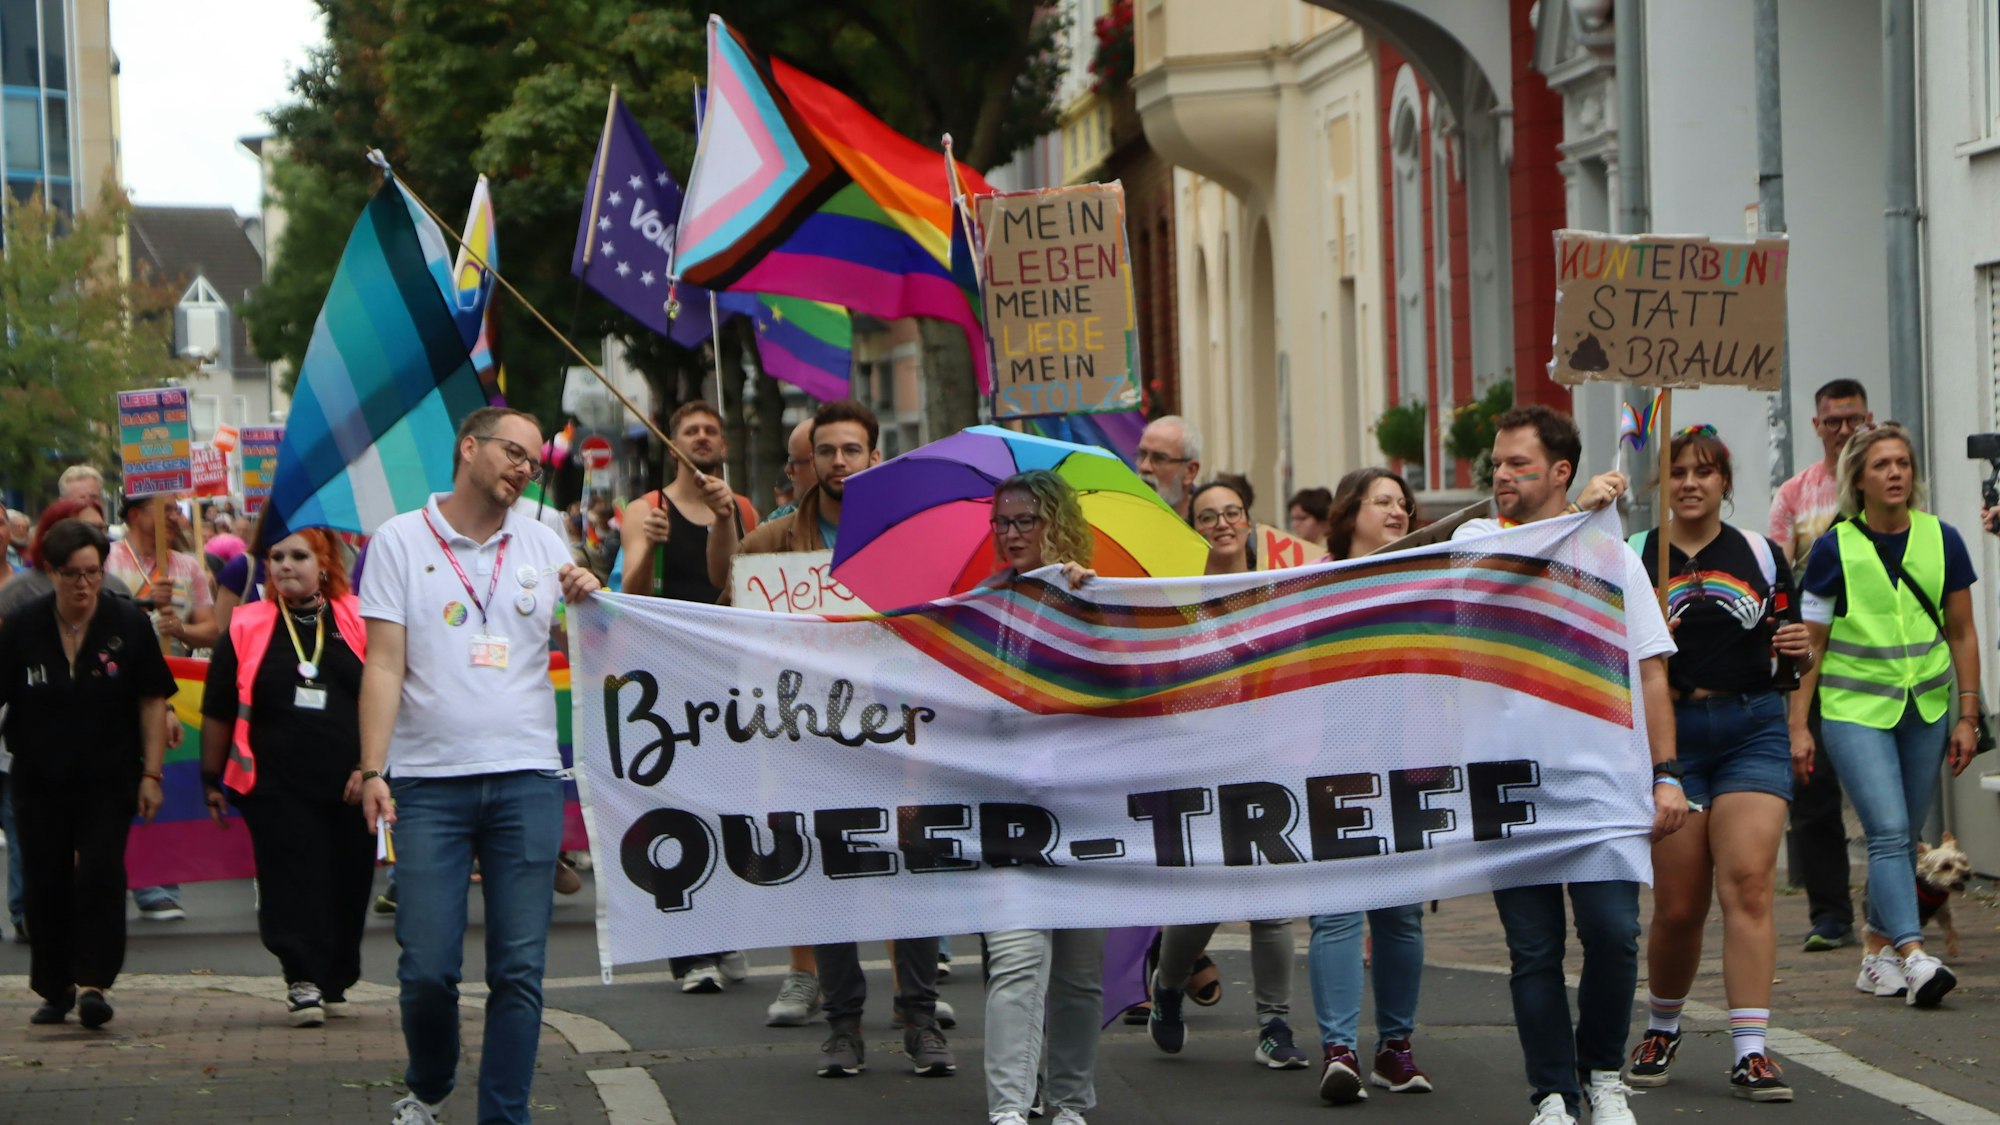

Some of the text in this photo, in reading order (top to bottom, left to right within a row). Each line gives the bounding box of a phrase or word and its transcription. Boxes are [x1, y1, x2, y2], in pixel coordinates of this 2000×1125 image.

[1003, 199, 1104, 243] MEIN
[988, 243, 1116, 287] LEBEN
[1560, 240, 1788, 286] KUNTERBUNT
[996, 284, 1092, 318] MEINE
[1588, 284, 1738, 331] STATT
[1003, 316, 1105, 356] LIEBE
[1011, 354, 1095, 383] MEIN
[120, 392, 158, 408] LEBE
[1002, 375, 1127, 416] STOLZ
[124, 458, 190, 474] DAGEGEN
[132, 473, 184, 494] HÄTTE!
[603, 668, 936, 788] Brühler
[620, 758, 1540, 913] QUEER-TREFF
